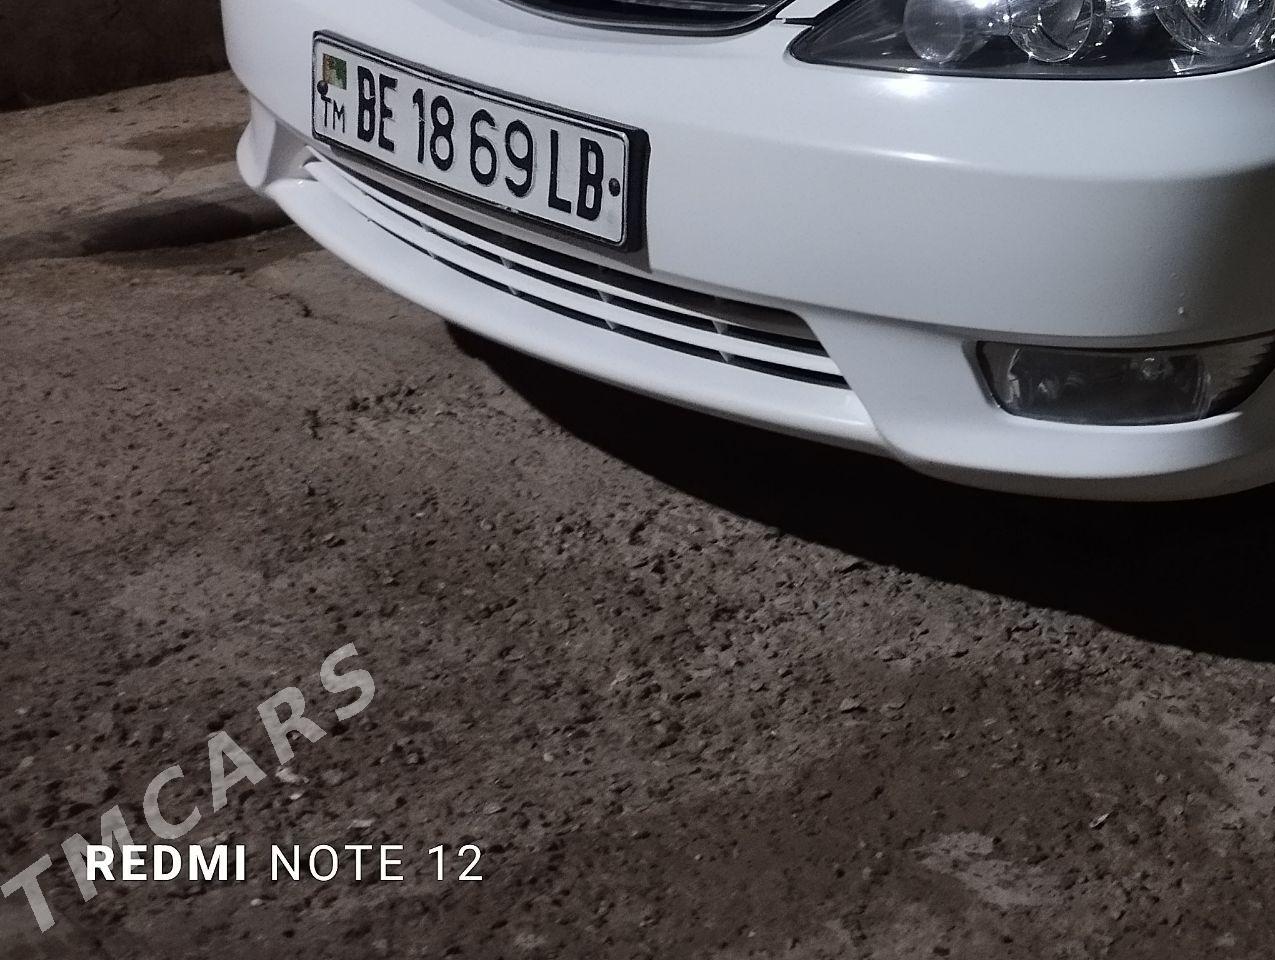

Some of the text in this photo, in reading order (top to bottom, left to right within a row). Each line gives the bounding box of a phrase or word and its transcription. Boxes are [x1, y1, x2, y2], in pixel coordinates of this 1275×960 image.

[320, 92, 346, 134] TM
[356, 65, 604, 222] BE 18 69 LB
